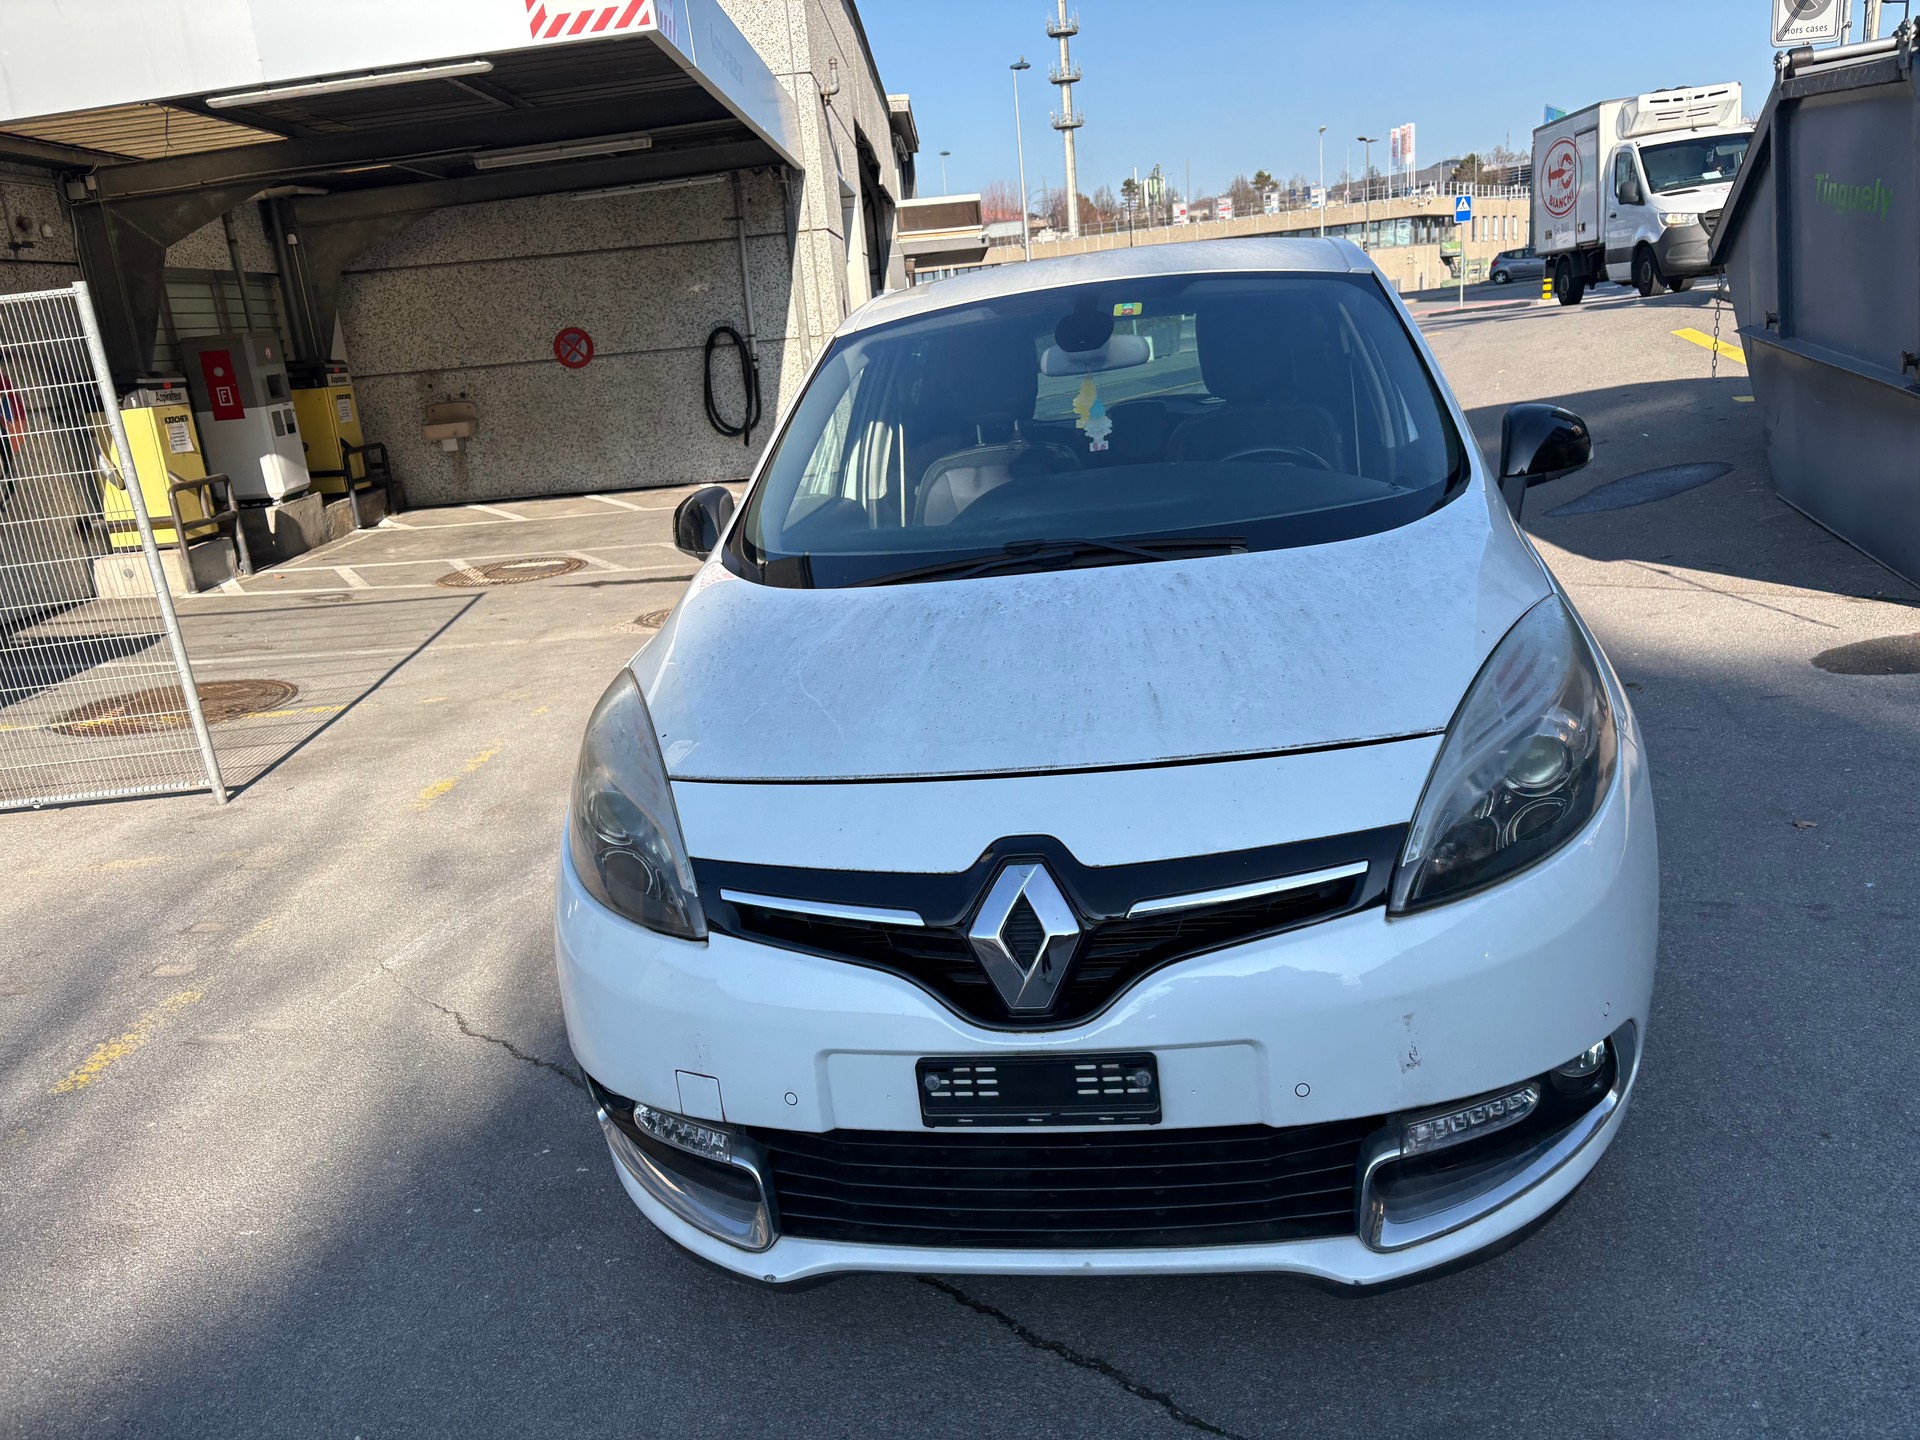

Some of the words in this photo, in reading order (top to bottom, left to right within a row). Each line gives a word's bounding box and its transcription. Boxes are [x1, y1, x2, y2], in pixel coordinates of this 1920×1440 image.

[1805, 24, 1828, 33] cases
[1549, 189, 1574, 208] BIANCHI
[1815, 173, 1893, 223] Tinguely
